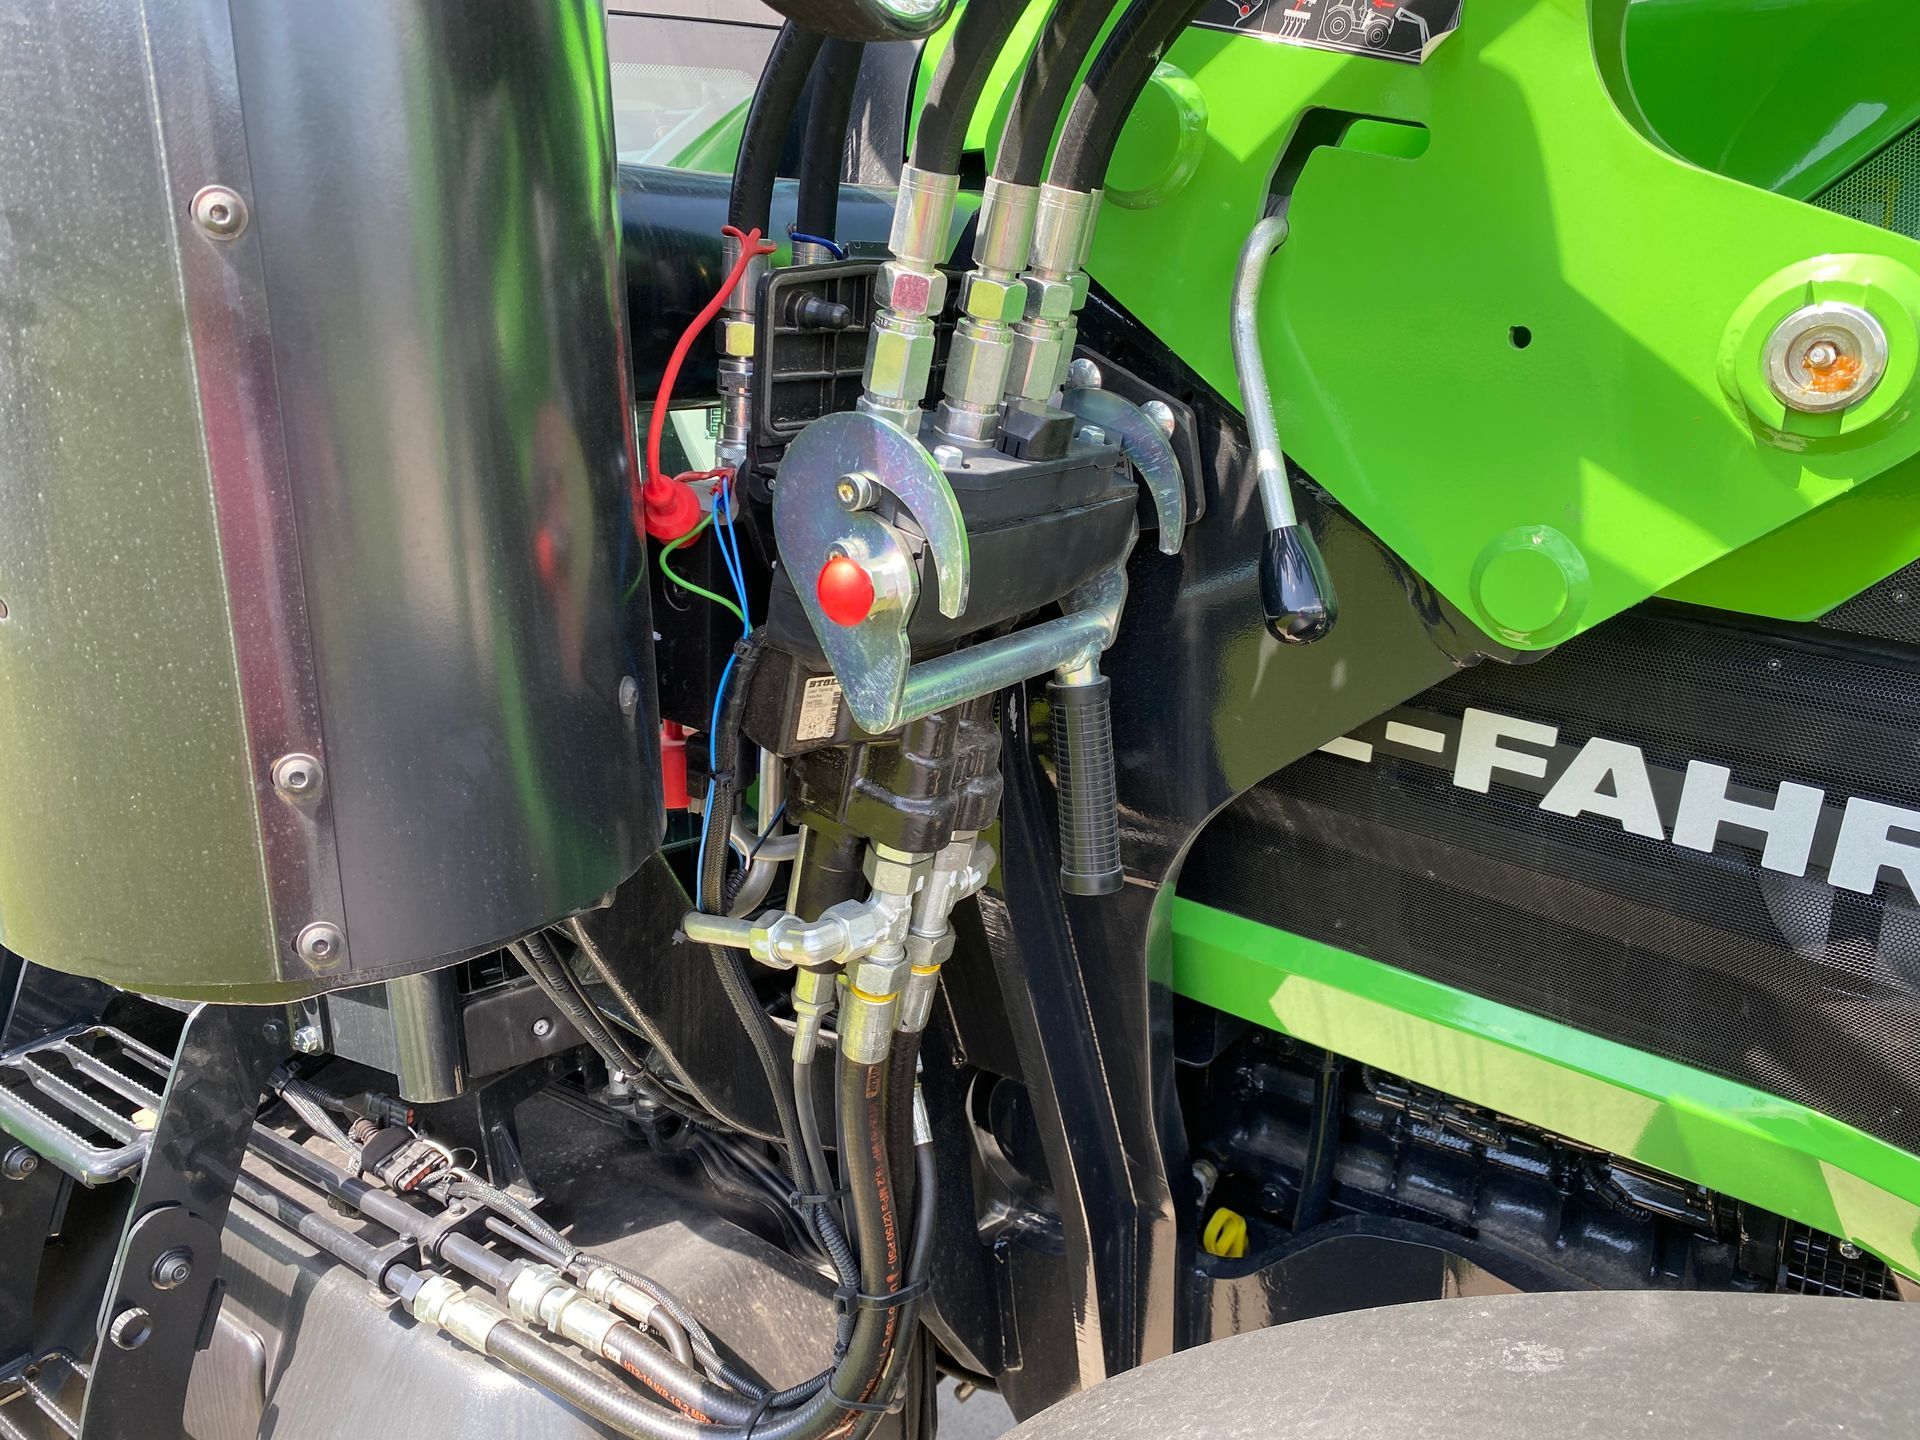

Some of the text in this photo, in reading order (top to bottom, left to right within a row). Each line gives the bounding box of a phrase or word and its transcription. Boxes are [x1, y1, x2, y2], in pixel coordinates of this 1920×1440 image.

[808, 679, 839, 688] STOL
[1319, 708, 1920, 904] -FAHR
[878, 1186, 890, 1212] MPa
[881, 1211, 895, 1241] (2750
